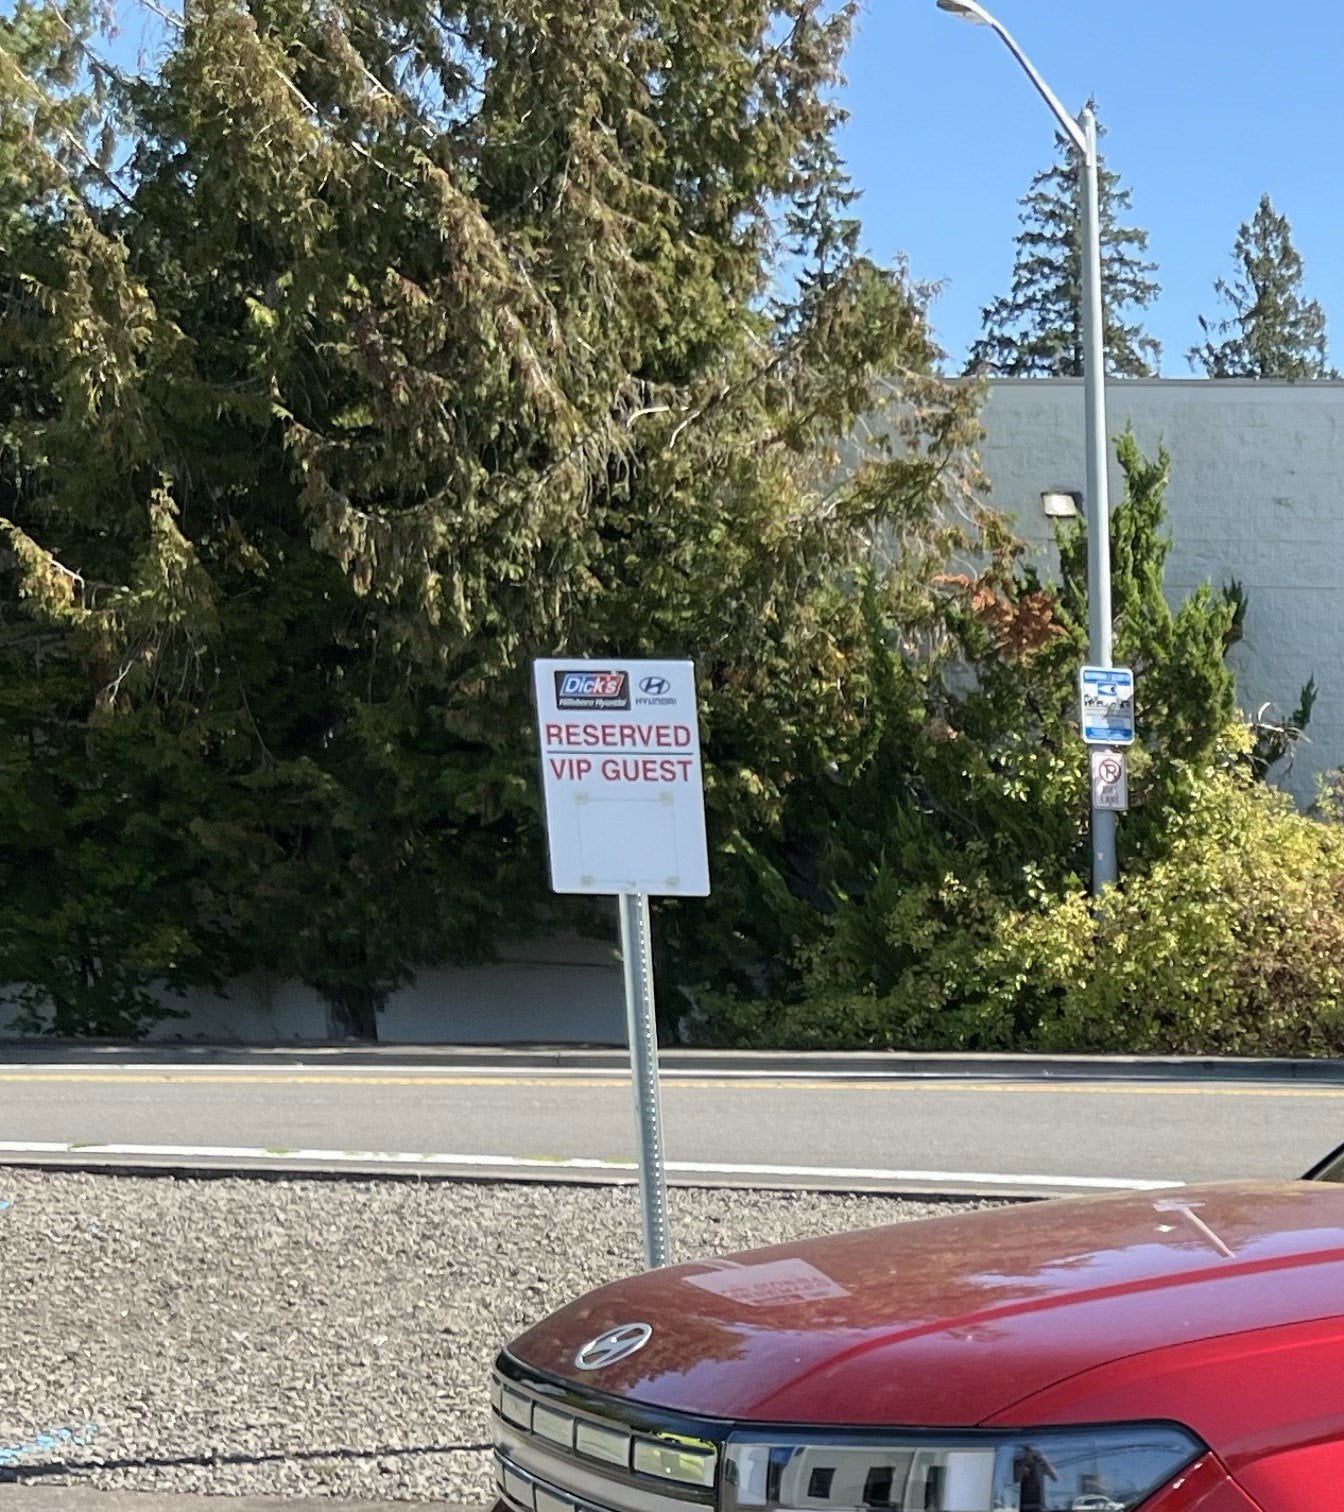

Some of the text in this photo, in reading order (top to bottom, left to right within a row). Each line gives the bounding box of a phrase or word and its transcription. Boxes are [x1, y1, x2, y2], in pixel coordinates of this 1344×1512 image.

[545, 723, 692, 748] RESERVED
[550, 758, 693, 783] VIP GUEST
